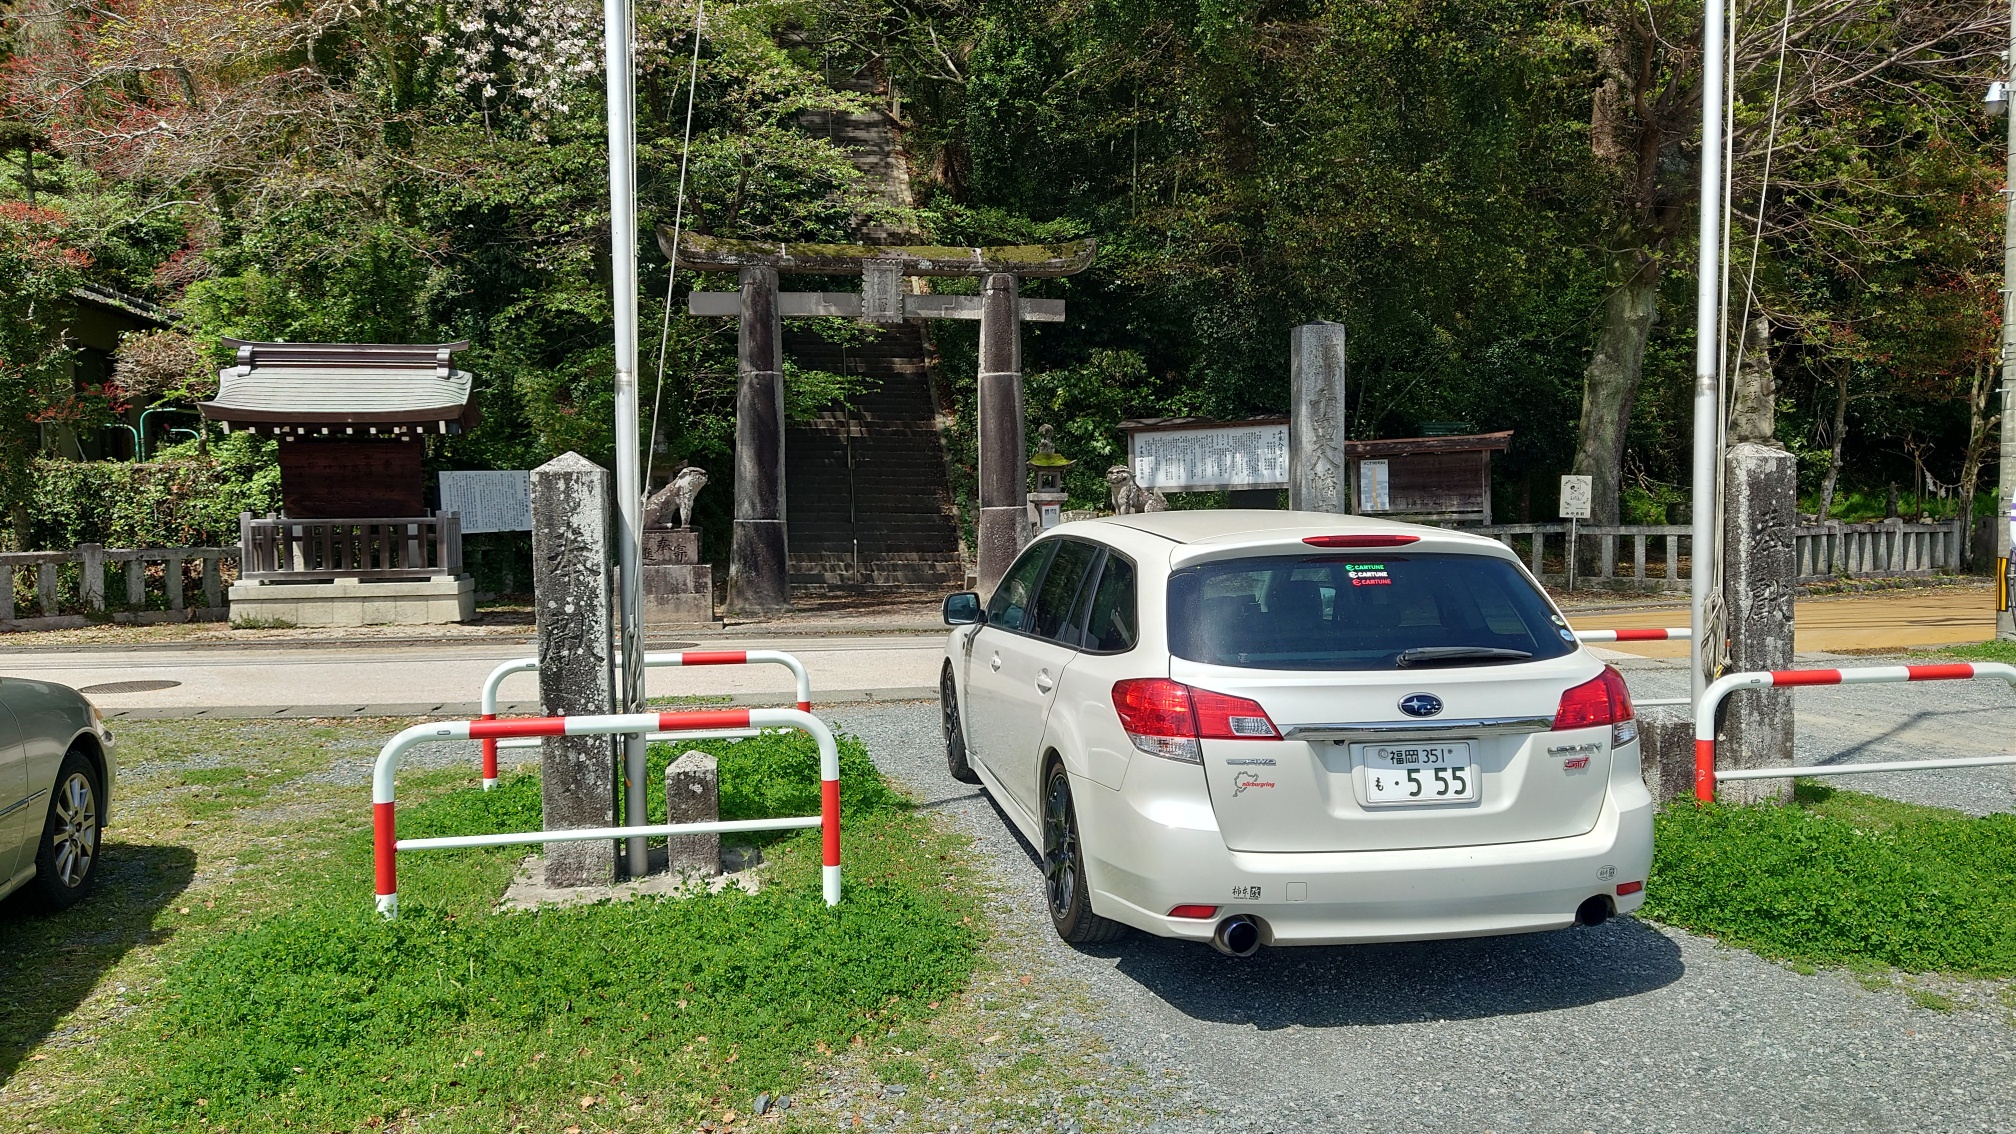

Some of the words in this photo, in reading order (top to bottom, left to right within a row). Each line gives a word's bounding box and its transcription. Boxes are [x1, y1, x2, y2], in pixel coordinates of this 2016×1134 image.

[1390, 749, 1420, 765] 福岡
[1422, 748, 1445, 764] 351
[1375, 776, 1385, 792] も
